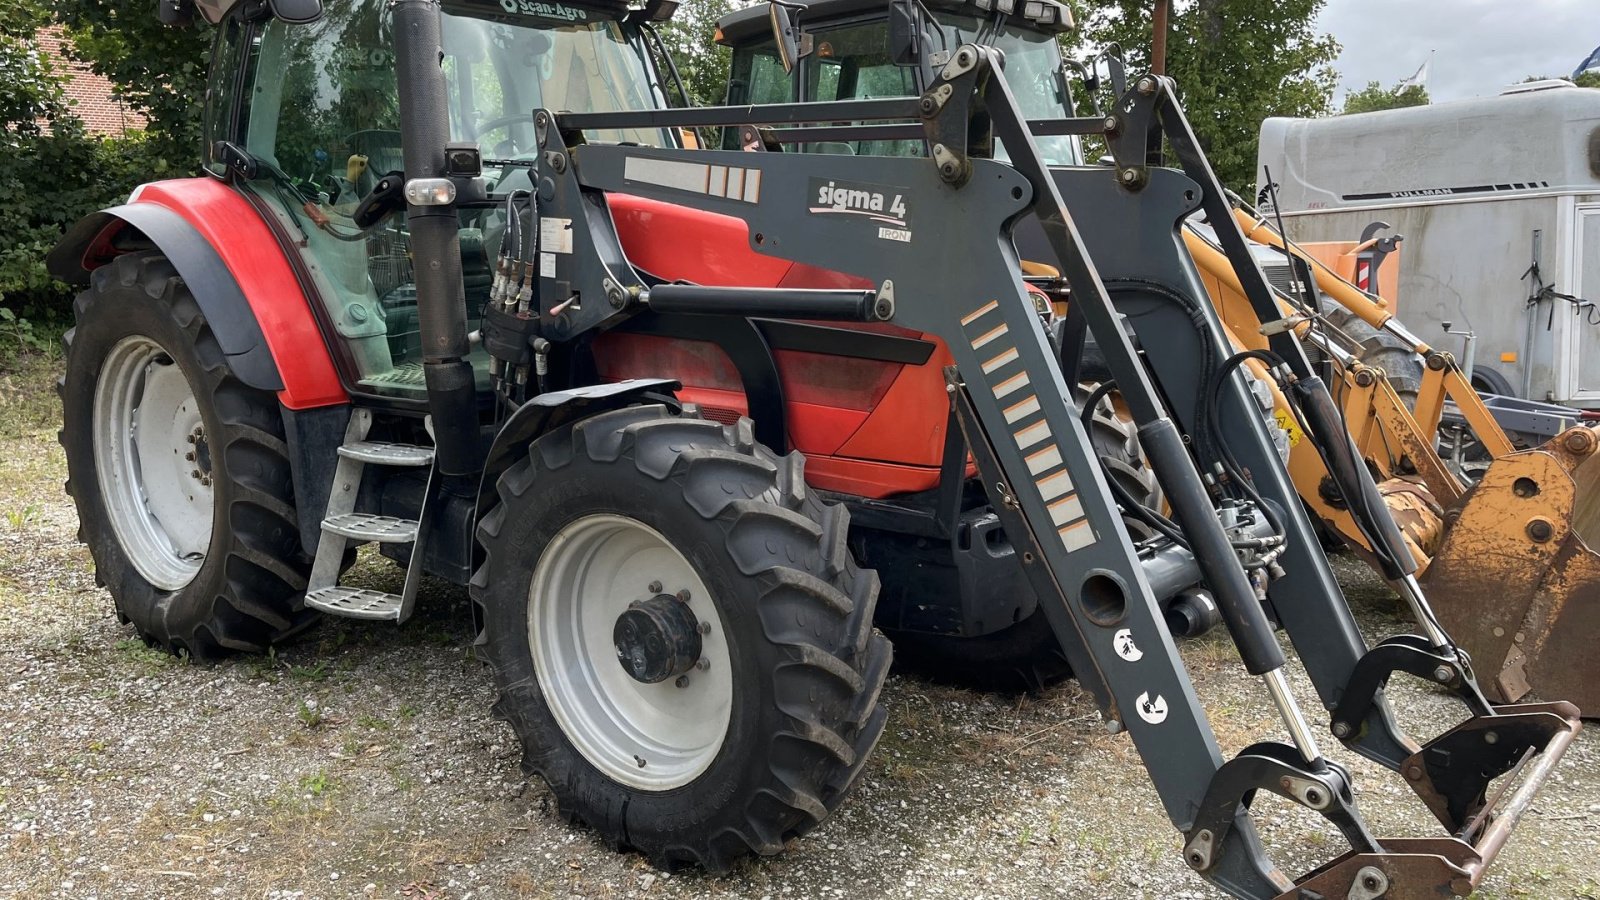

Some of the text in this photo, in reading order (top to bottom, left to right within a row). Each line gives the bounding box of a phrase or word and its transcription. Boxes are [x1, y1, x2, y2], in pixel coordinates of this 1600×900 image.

[520, 0, 587, 20] Scan-Agro
[818, 181, 906, 218] sigma 4
[1390, 188, 1453, 198] PULLMAN
